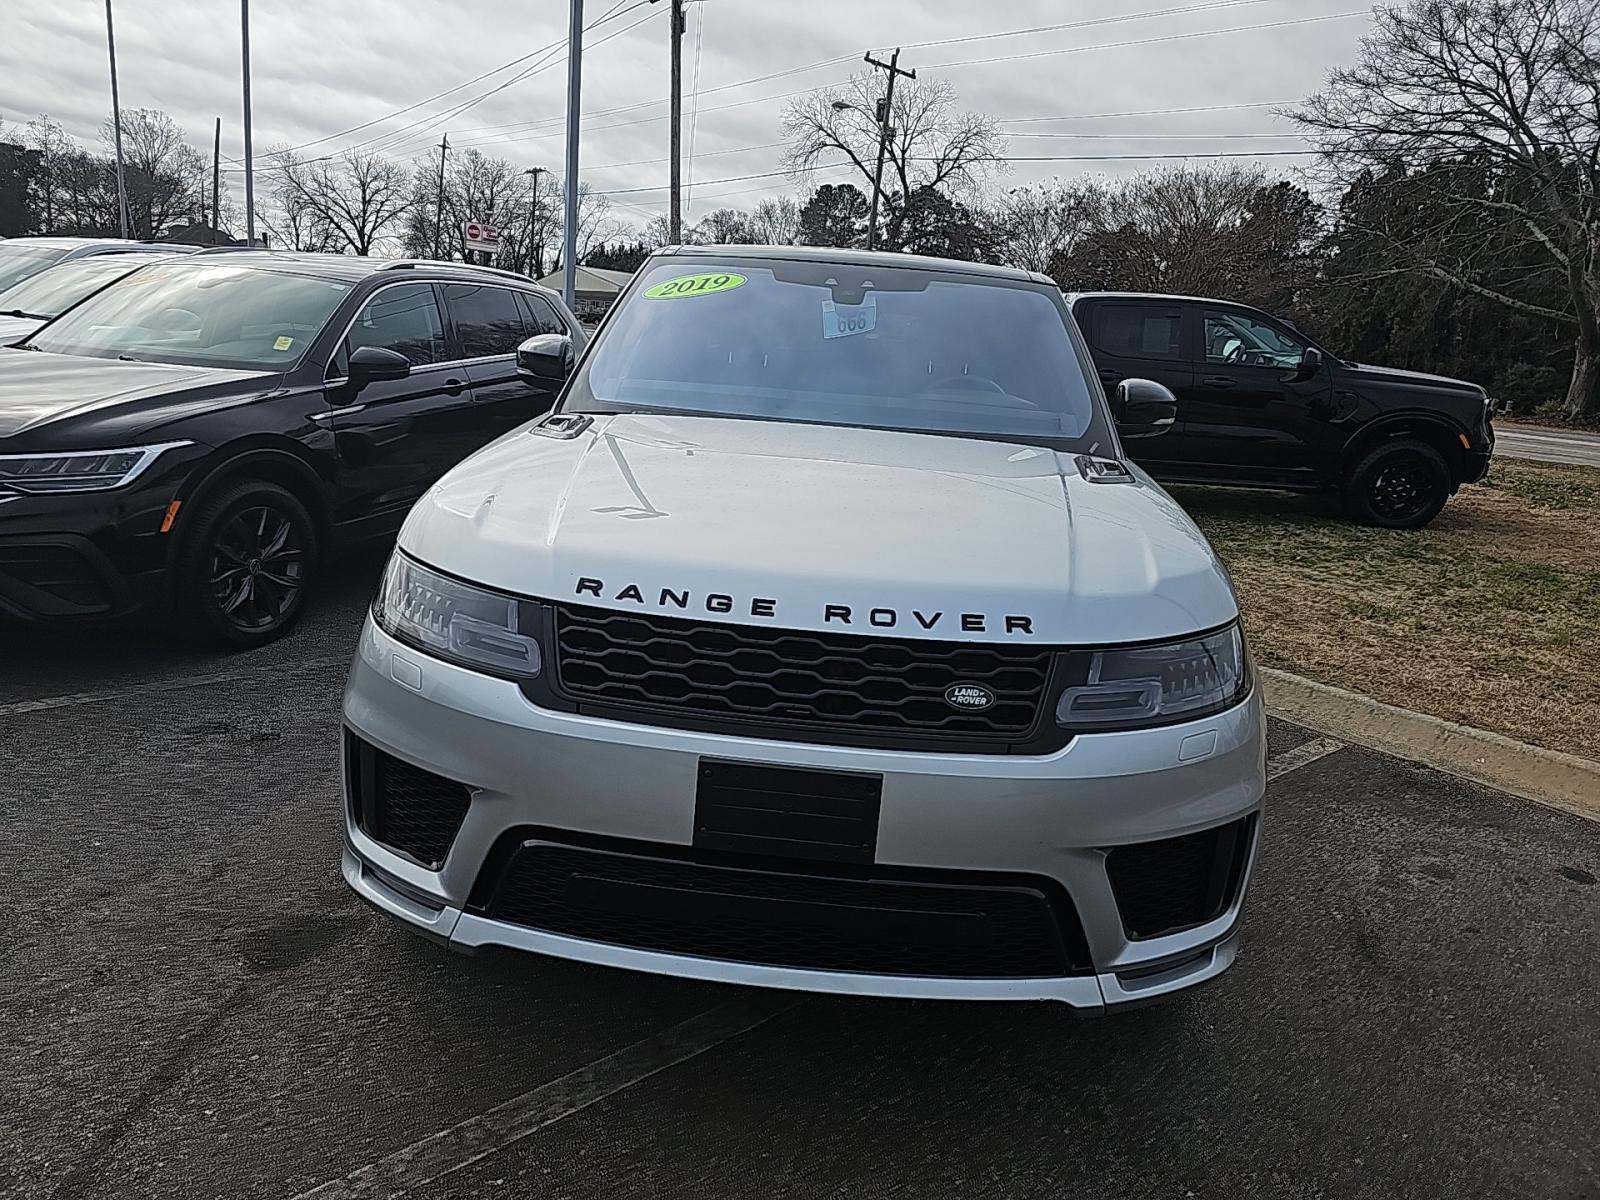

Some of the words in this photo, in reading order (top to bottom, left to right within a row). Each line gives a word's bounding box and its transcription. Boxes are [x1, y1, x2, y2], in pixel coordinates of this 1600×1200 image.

[658, 275, 731, 297] 2019
[575, 576, 777, 618] RANGE
[824, 604, 1034, 634] ROVER
